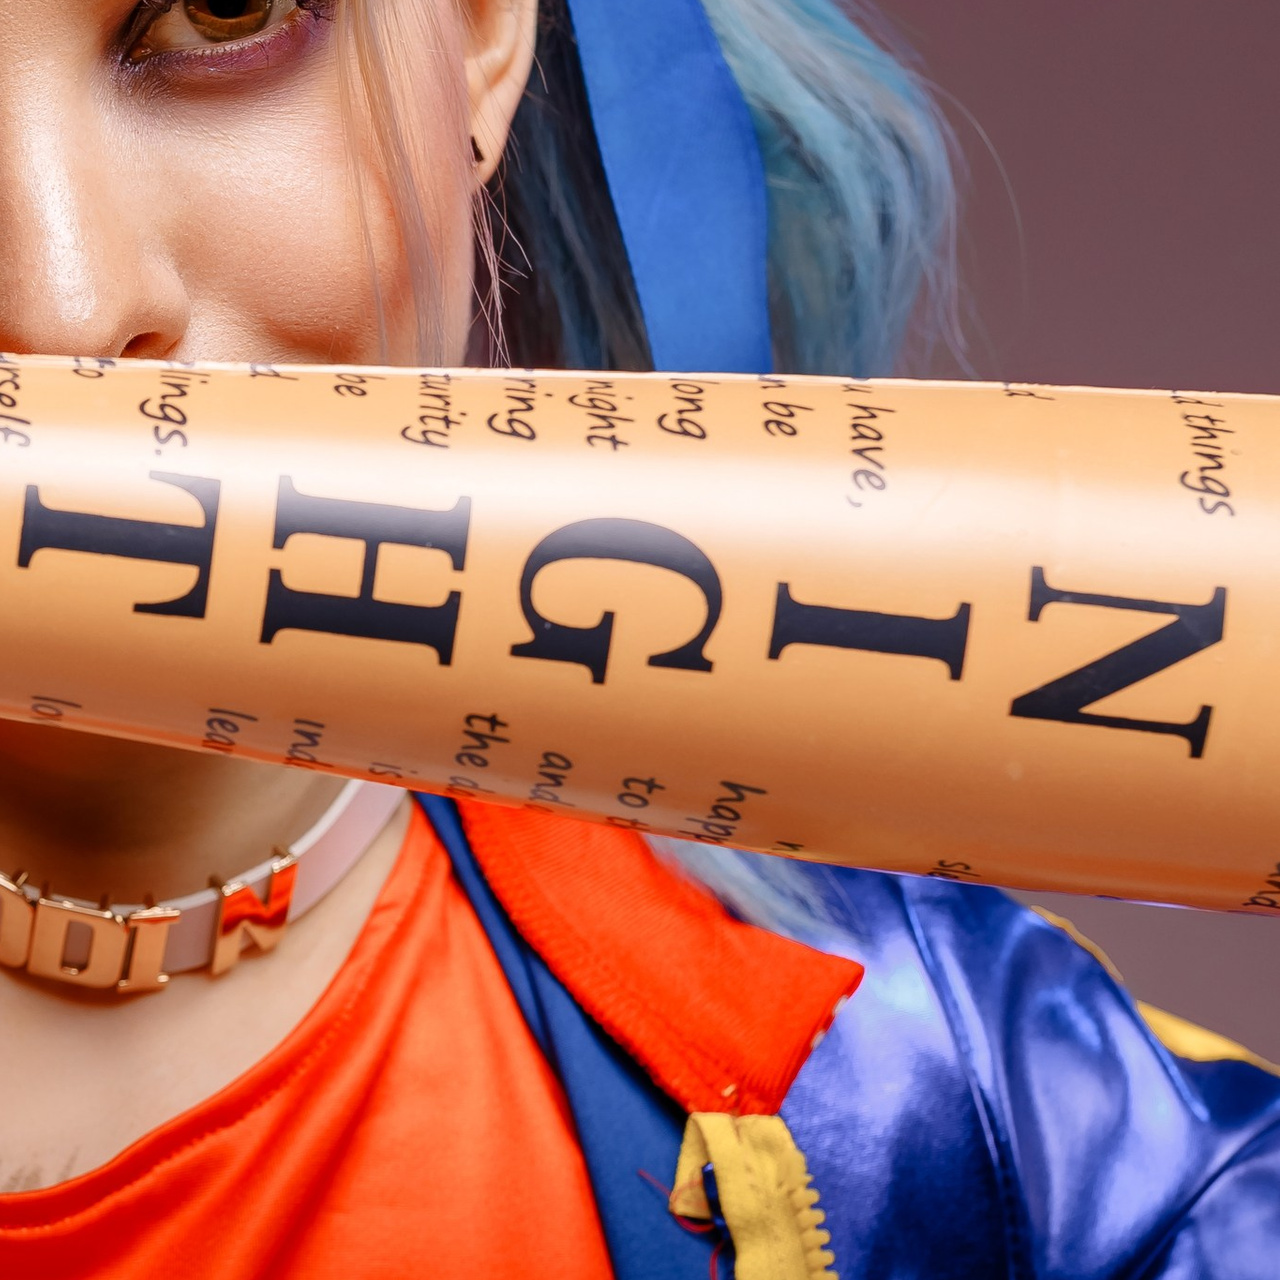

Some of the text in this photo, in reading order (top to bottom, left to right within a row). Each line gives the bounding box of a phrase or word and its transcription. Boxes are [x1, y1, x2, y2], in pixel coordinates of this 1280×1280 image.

[762, 401, 815, 438] be
[844, 403, 896, 508] have,
[1179, 413, 1237, 517] things
[454, 713, 511, 769] the
[616, 777, 667, 809] to
